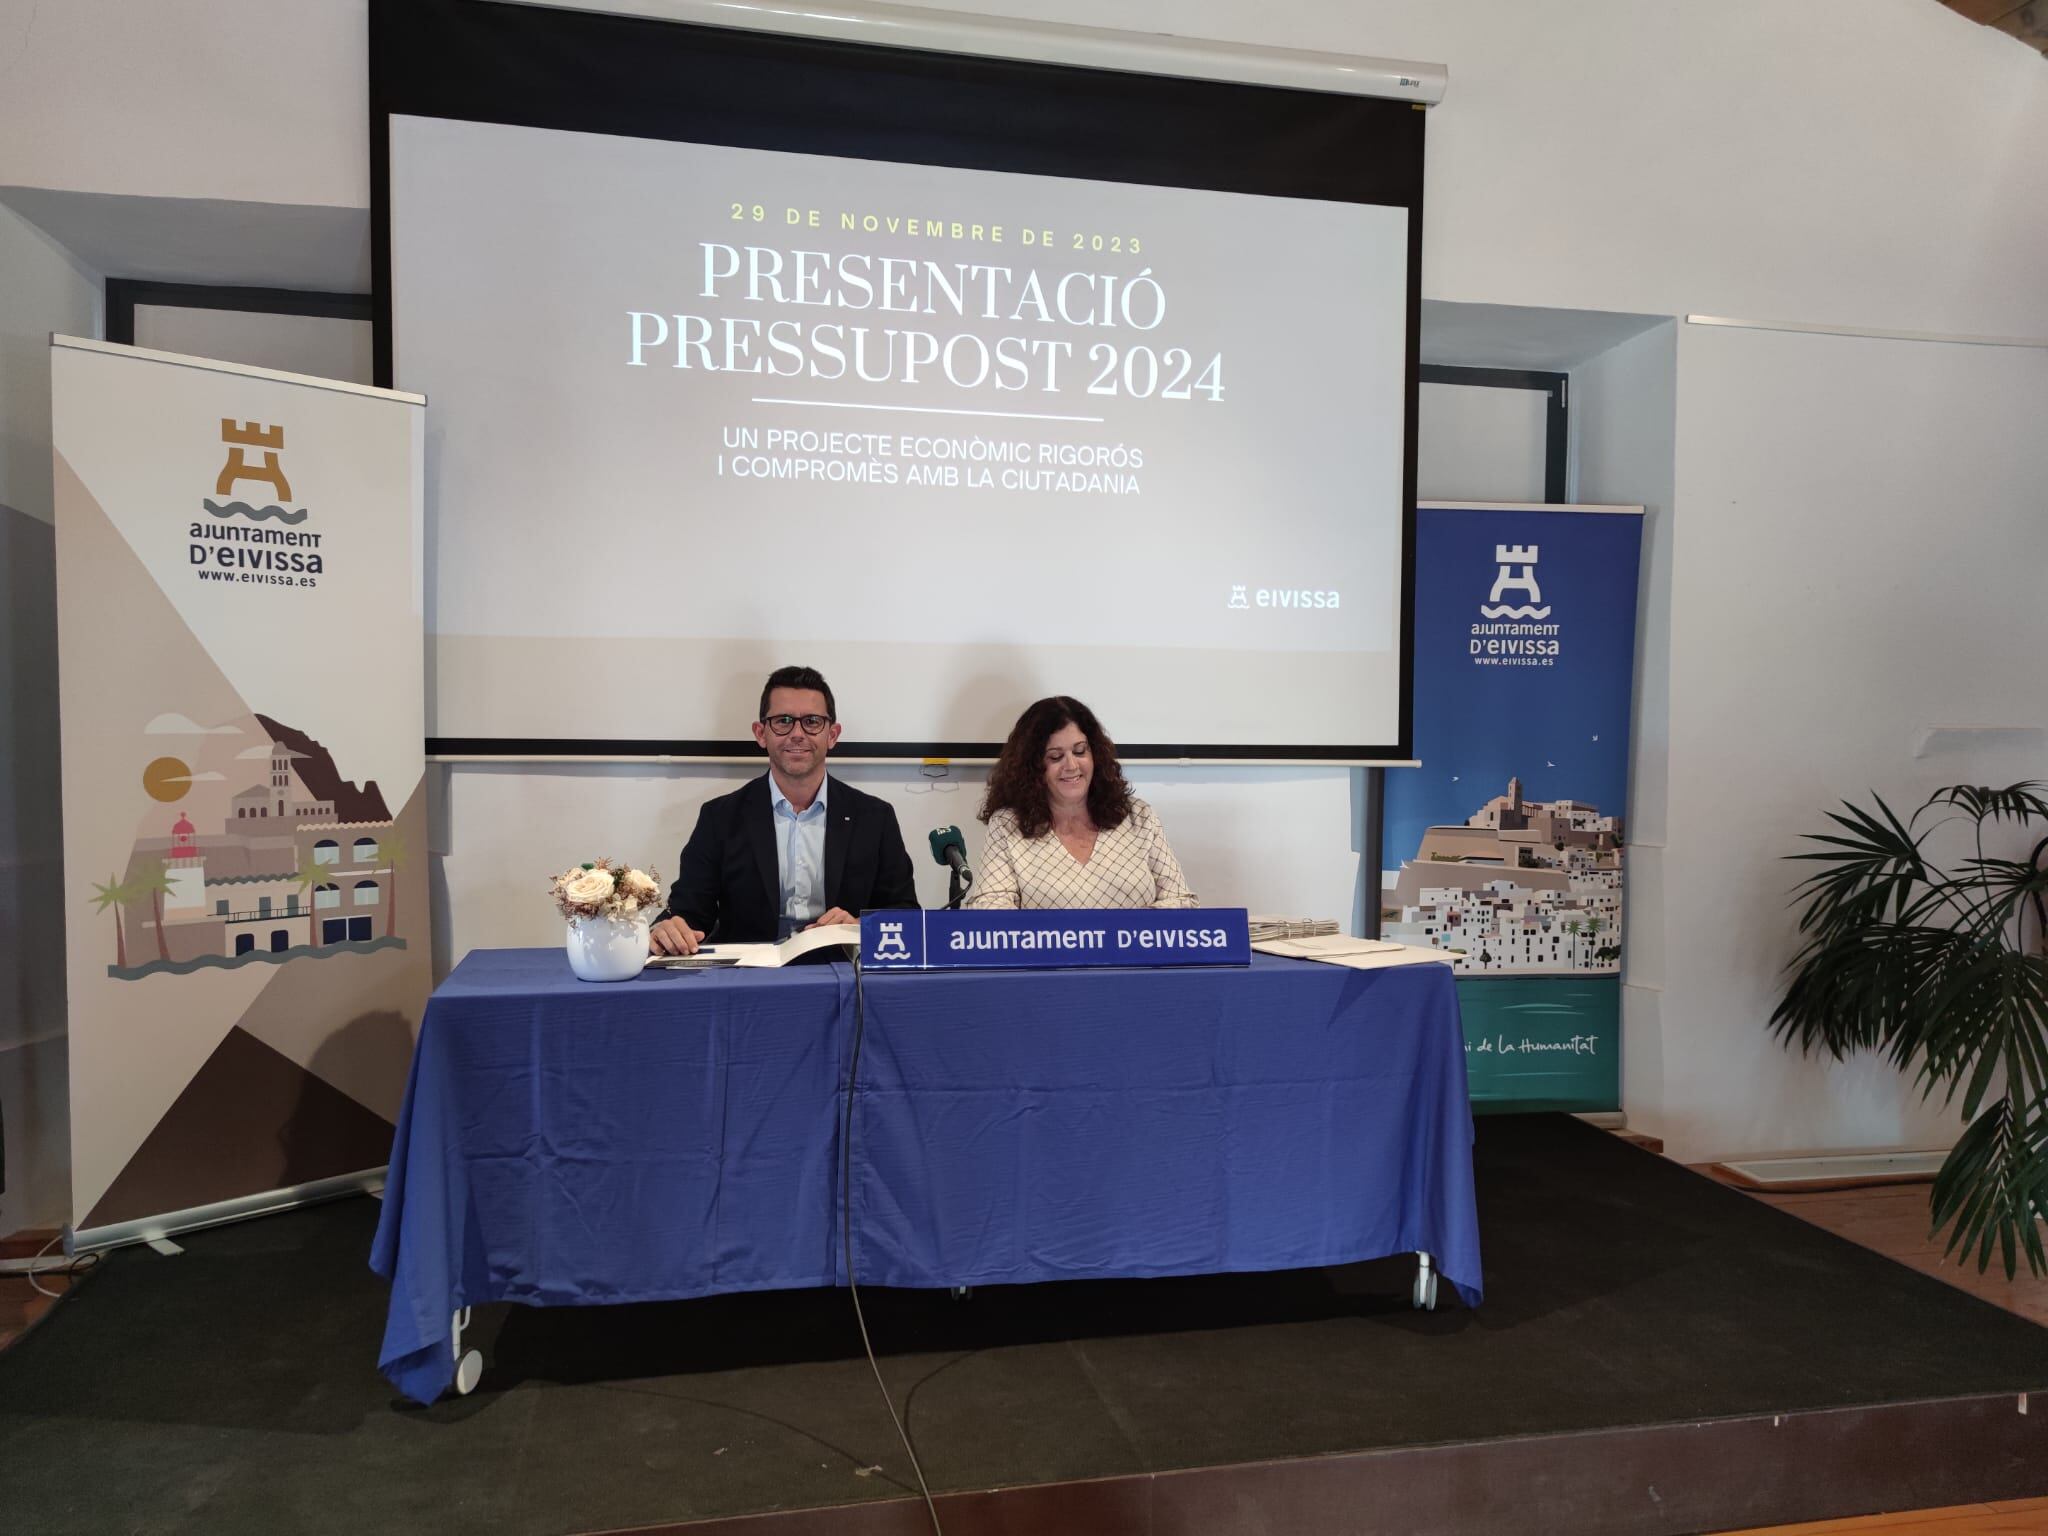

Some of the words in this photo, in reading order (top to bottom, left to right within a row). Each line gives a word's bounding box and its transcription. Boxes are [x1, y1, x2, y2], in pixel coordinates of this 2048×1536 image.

[731, 203, 765, 222] 29
[786, 208, 820, 227] DE
[841, 213, 1003, 243] NOVEMBRE
[1022, 229, 1054, 247] DE
[1073, 234, 1141, 255] 2023
[699, 242, 1166, 330] PRESENTACIÓ
[626, 312, 1072, 393] PRESSUPOST
[1087, 344, 1225, 402] 2024
[723, 426, 758, 449] UN
[767, 429, 892, 456] PROJECTE
[900, 435, 1031, 463] ECONÒMIC
[1039, 443, 1143, 468] RIGORÓS
[718, 454, 723, 476] I
[732, 455, 898, 484] COMPROMÈS
[906, 464, 959, 488] AMB
[967, 467, 995, 488] LA
[1001, 469, 1140, 495] CIUTADANIA
[1477, 1038, 1492, 1052] de
[1498, 1034, 1515, 1054] la
[1518, 1034, 1599, 1055] Humanitat
